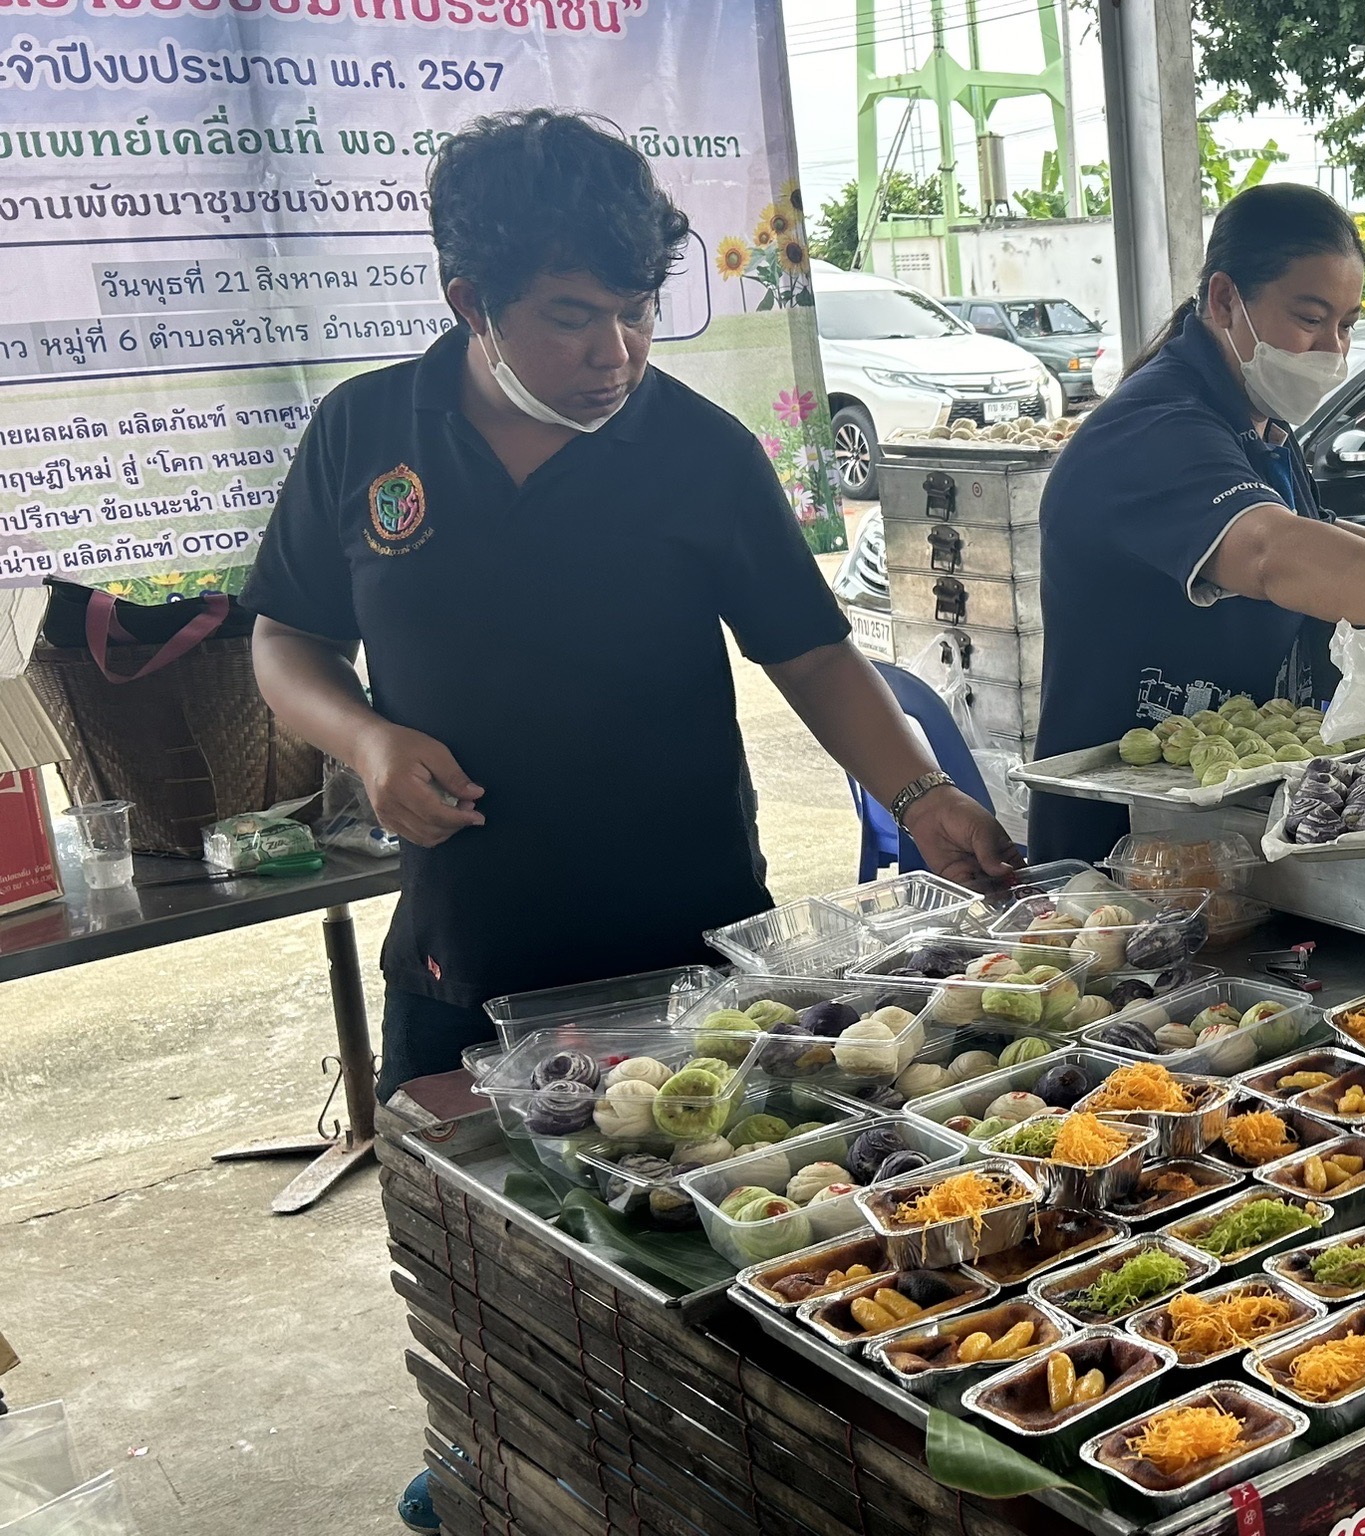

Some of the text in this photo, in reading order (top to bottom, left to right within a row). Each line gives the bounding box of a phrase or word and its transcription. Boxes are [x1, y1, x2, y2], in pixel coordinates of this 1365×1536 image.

[331, 60, 406, 89] พ.ศ.
[419, 60, 504, 92] 2567
[102, 260, 428, 304] วันพุธที่ 21 สิงหาคม 2567
[41, 319, 106, 364] หมู่ที่
[119, 330, 137, 352] 6
[149, 316, 309, 351] ตำบลหัวไทร
[119, 403, 225, 435] ผลิตภัณฑ์
[122, 454, 139, 485] สู่
[213, 448, 275, 468] หนอง
[101, 492, 212, 521] ข้อแนะนำ
[0, 531, 249, 574] น่าย ผลิตภัณฑ์ OTOP
